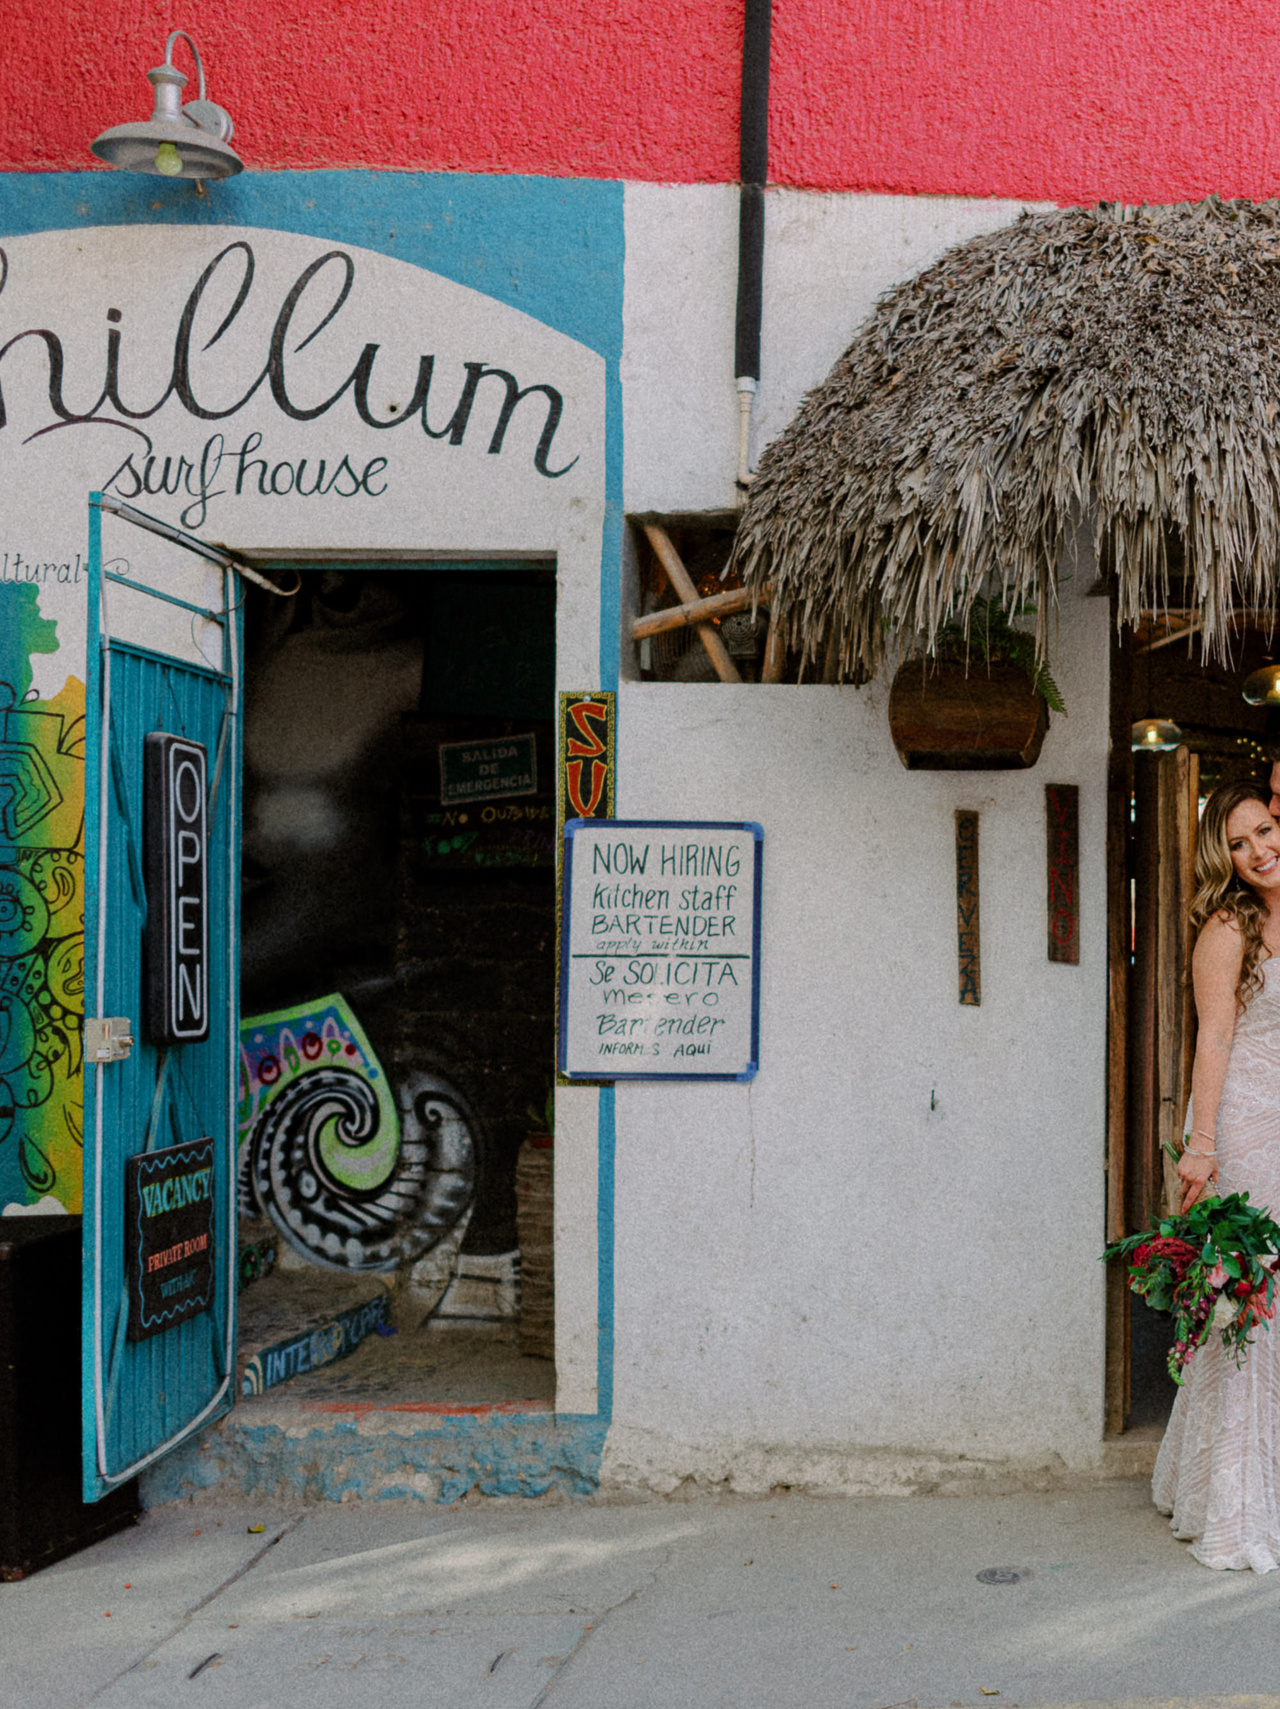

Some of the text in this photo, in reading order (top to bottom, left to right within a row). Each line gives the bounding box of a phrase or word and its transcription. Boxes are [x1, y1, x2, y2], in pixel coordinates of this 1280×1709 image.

[460, 745, 518, 764] SALIDA
[478, 762, 500, 776] DE
[448, 773, 532, 797] EMERGENCIA
[593, 843, 740, 877] NOW HIRING
[1049, 789, 1075, 945] VINO
[175, 760, 200, 1022] OPEN
[678, 884, 737, 911] staff
[957, 818, 979, 1003] CERVEZA
[591, 914, 736, 937] BARTENDER
[596, 937, 709, 955] apply within
[589, 960, 615, 985] Se
[596, 1013, 726, 1037] Barender
[598, 1042, 660, 1056] INFORMS
[142, 1166, 211, 1218] VACANCY
[147, 1232, 208, 1274] PRIVATE ROOM
